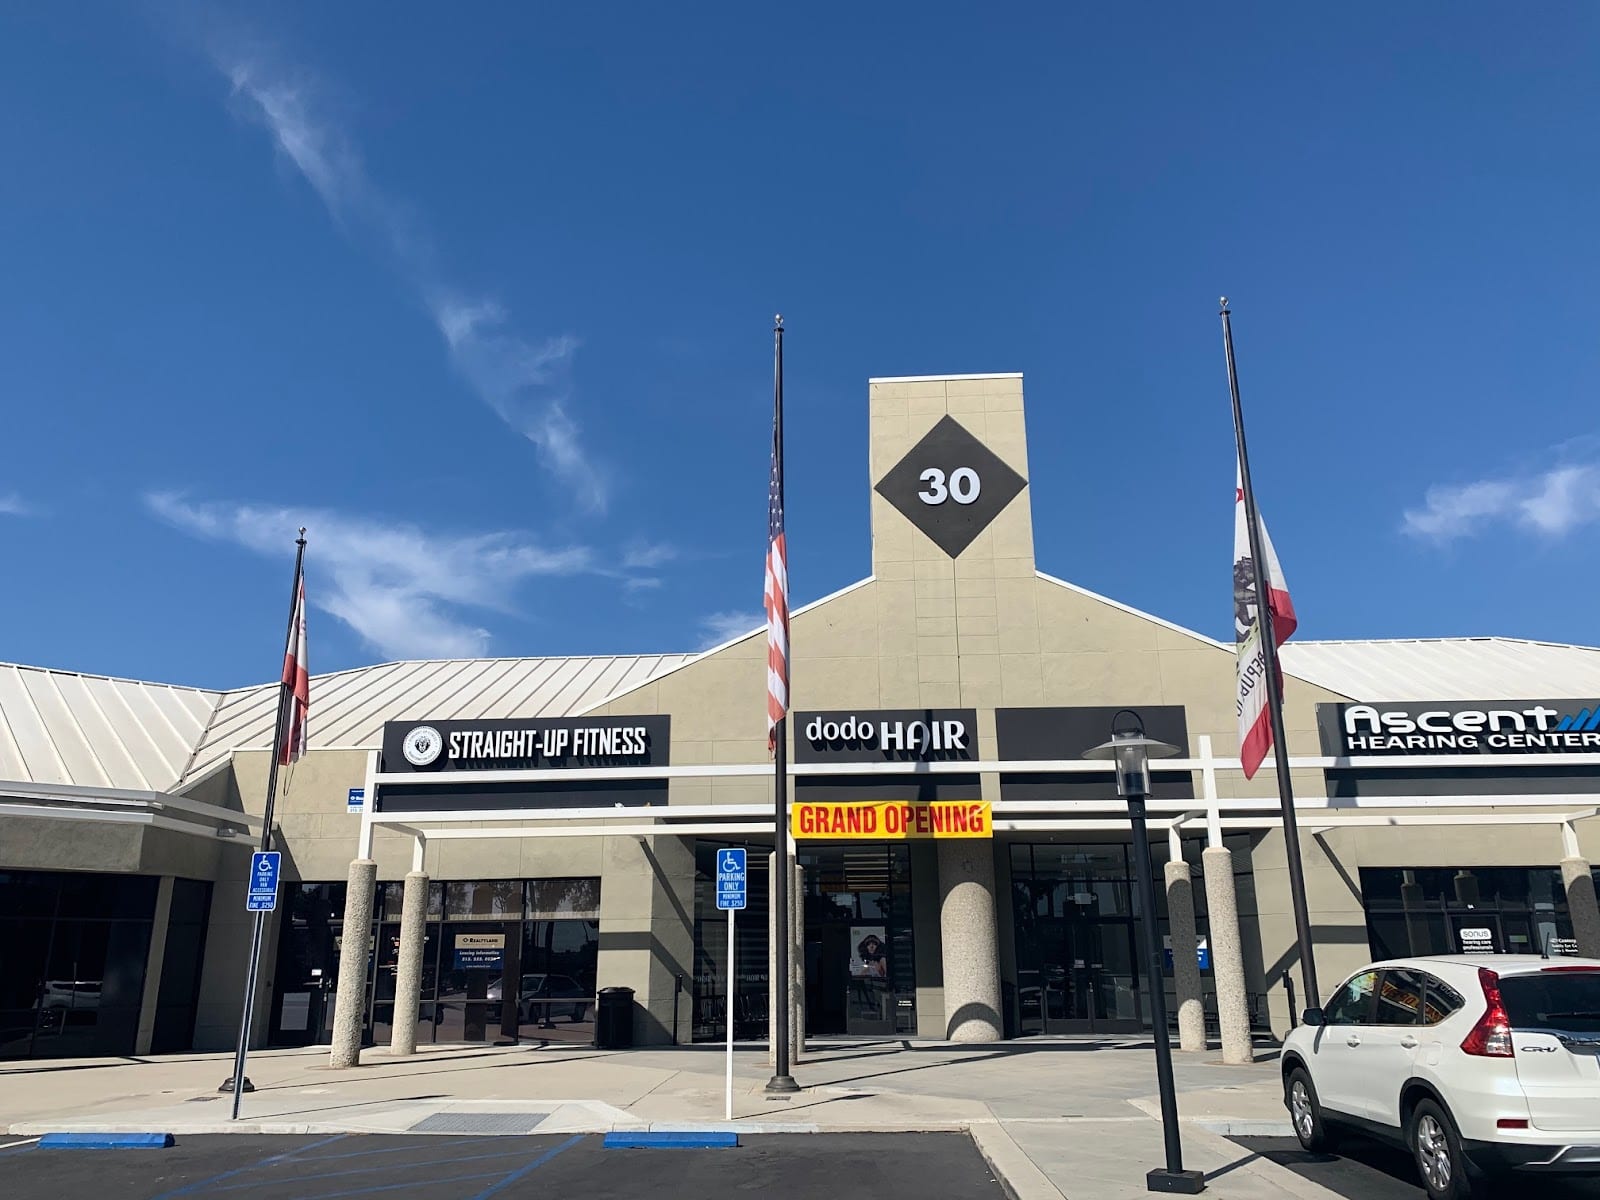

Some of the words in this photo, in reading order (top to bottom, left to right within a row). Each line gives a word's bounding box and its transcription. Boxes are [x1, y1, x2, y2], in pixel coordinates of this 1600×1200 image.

[918, 467, 981, 505] 30
[1344, 705, 1558, 734] Ascent
[448, 729, 568, 759] STRAIGHT-UP
[573, 727, 646, 756] FITNESS
[805, 716, 874, 740] dodo
[880, 720, 966, 754] HAIR
[1347, 734, 1478, 749] HEARING
[1487, 733, 1600, 748] CENTER
[799, 805, 877, 834] GRAND
[885, 804, 984, 833] OPENING
[720, 872, 744, 881] PARKING
[723, 881, 739, 890] ONLY
[1463, 930, 1489, 938] sonus
